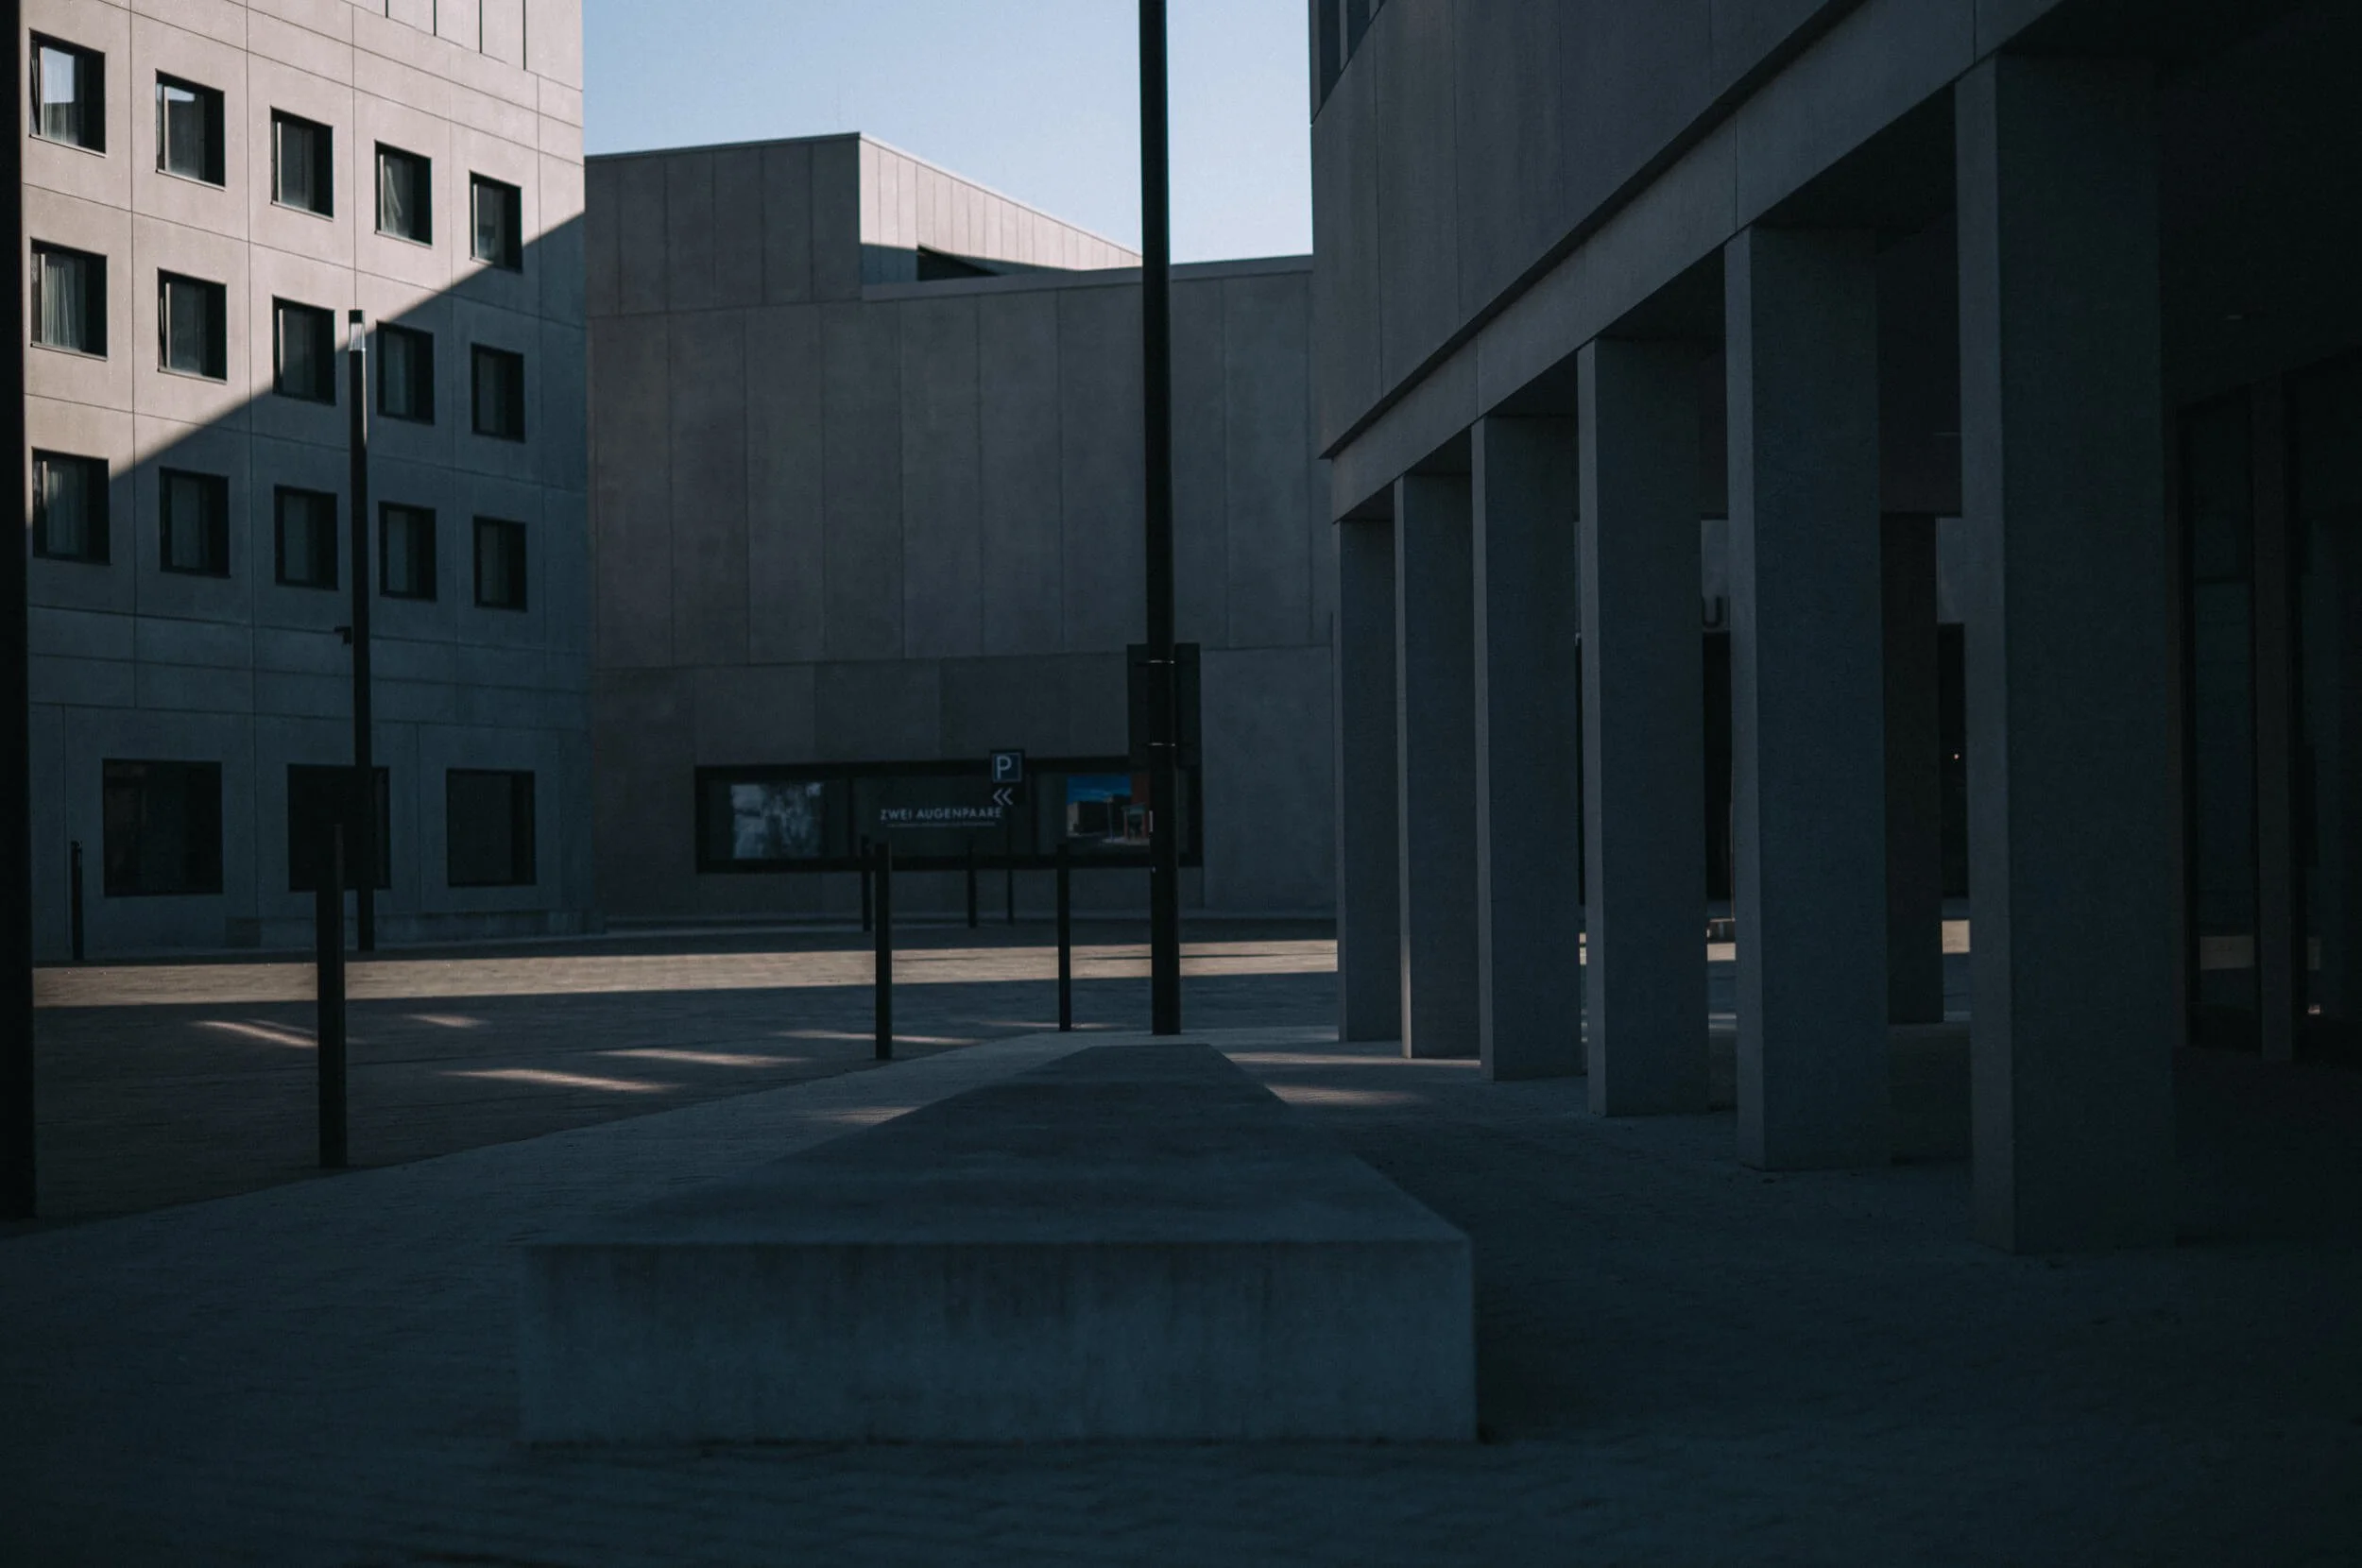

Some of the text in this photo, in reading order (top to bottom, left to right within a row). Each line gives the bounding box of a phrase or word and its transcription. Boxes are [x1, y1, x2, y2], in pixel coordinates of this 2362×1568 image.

[996, 755, 1012, 780] P
[880, 806, 1002, 821] ZWEI AUGENPAARE
